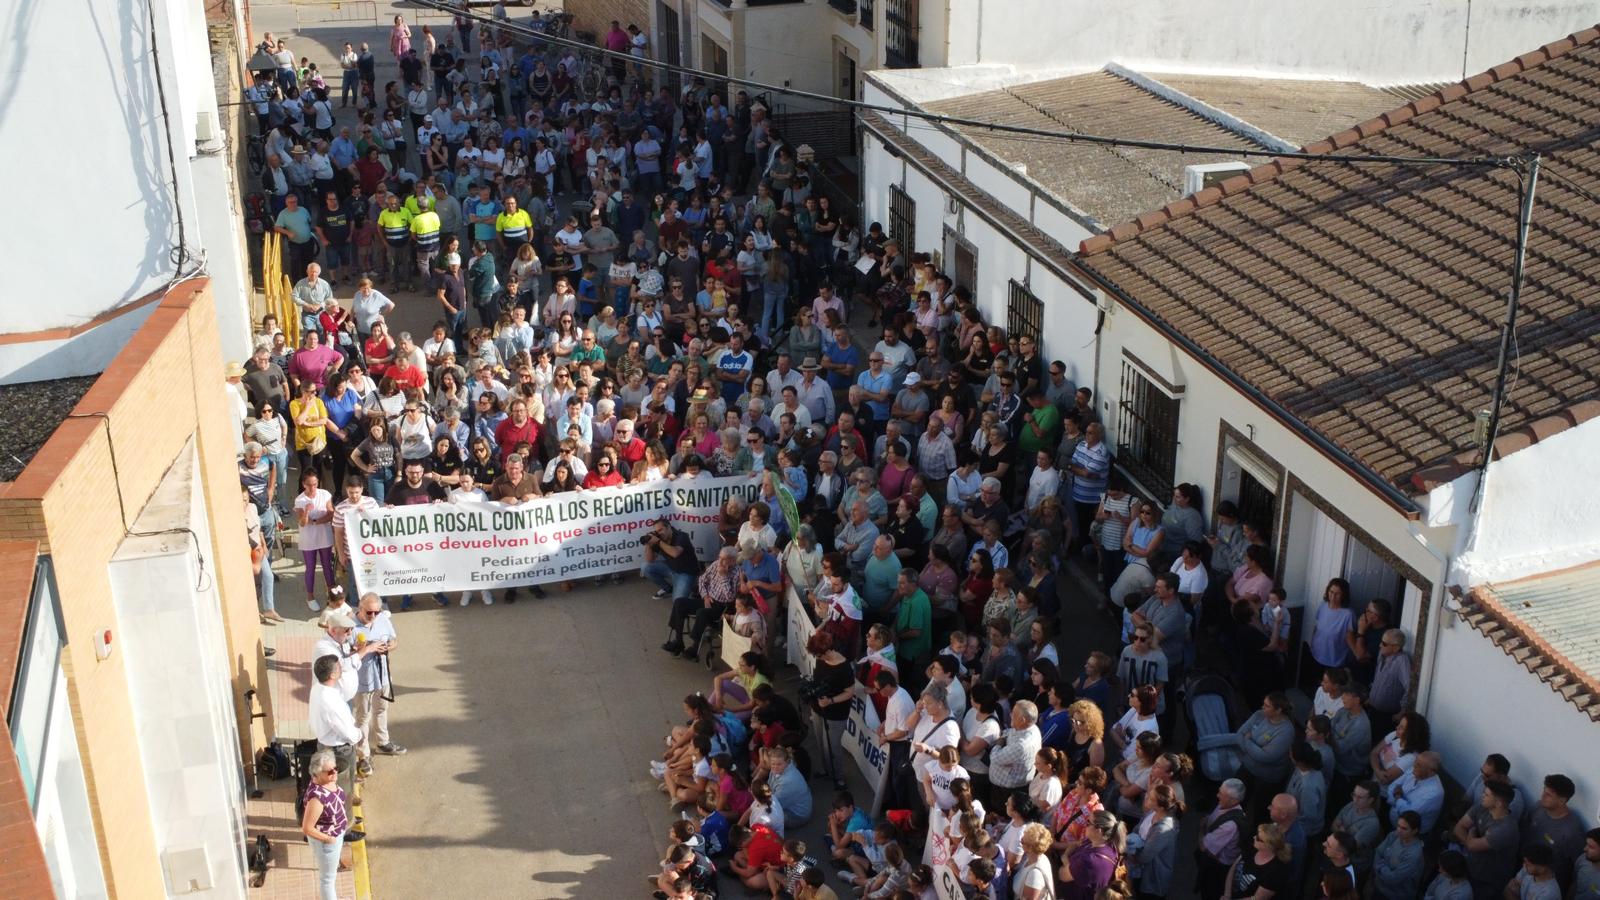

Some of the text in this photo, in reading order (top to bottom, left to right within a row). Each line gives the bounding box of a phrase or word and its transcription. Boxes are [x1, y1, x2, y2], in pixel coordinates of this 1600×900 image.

[360, 514, 429, 538] CAÑADA
[434, 511, 488, 533] ROSAL
[492, 504, 555, 531] CONTRA
[559, 499, 588, 521] LOS
[593, 488, 672, 516] RECORTES
[361, 543, 397, 556] Que
[403, 542, 433, 552] nos
[440, 535, 529, 550] devuelvan
[534, 532, 548, 545] lo
[553, 528, 582, 543] que
[588, 517, 656, 534] siempre
[383, 573, 446, 586] Cañada Rosal
